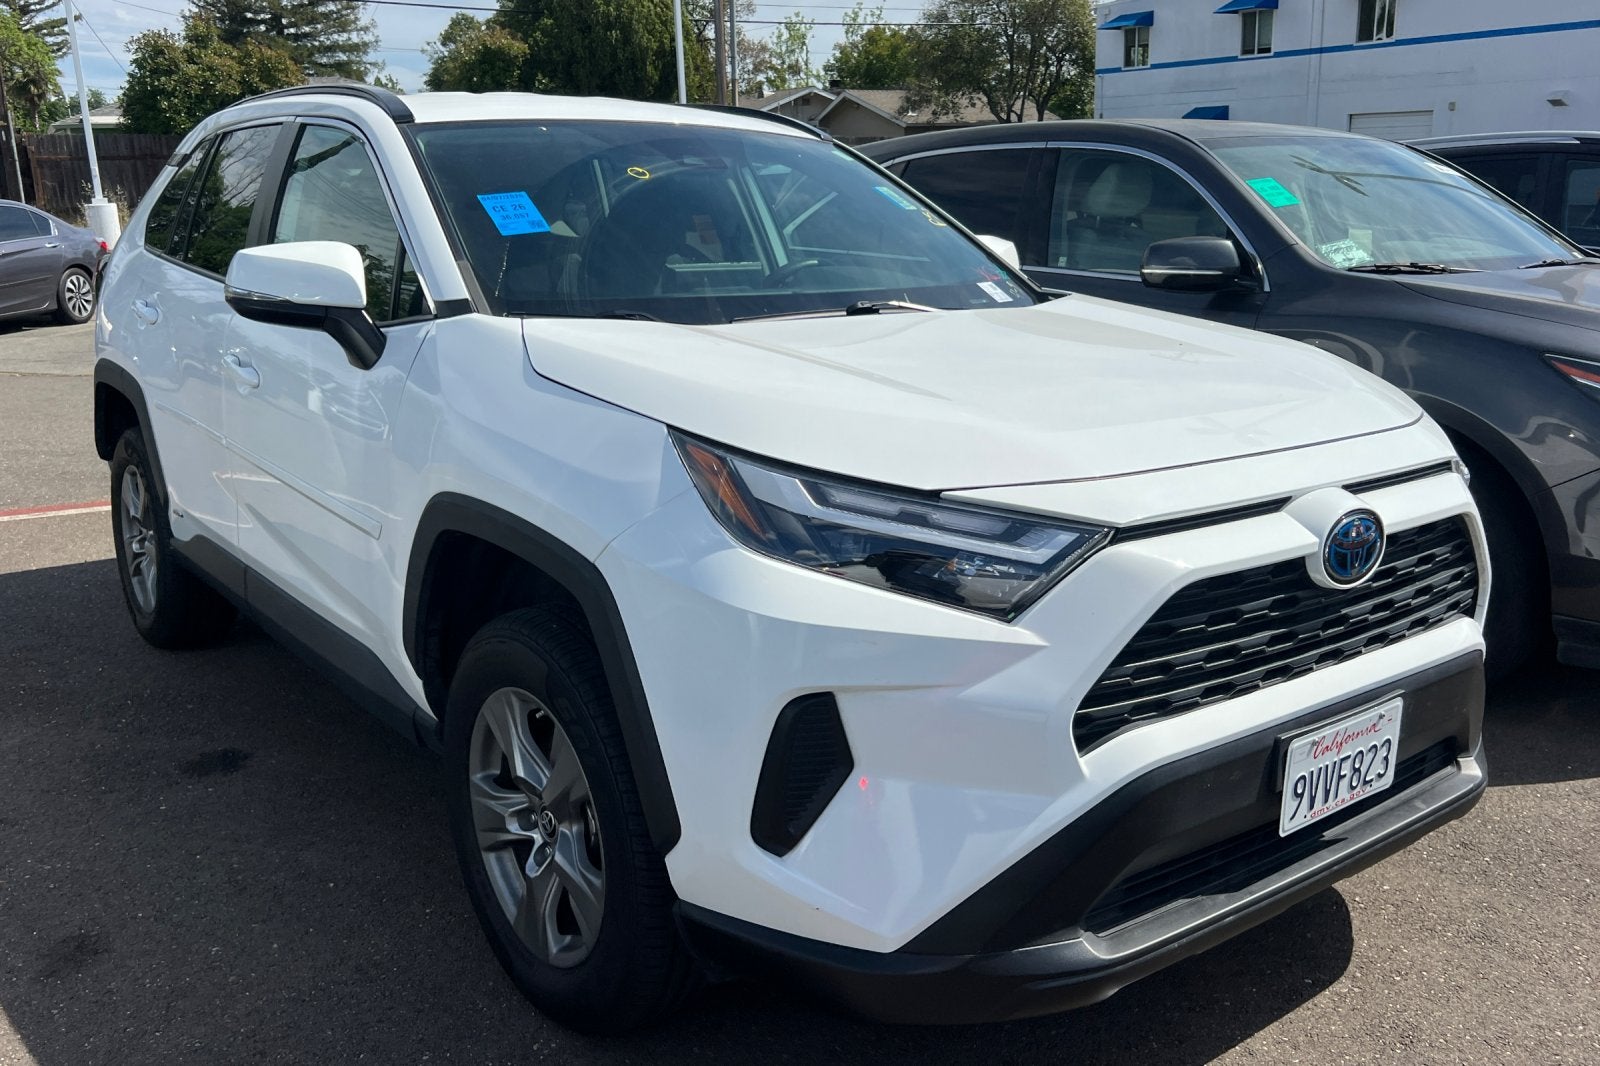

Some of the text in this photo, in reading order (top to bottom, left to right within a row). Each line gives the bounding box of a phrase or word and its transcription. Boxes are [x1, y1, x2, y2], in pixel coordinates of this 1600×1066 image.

[492, 203, 526, 213] CE 26
[1313, 721, 1381, 760] California
[1290, 738, 1392, 821] 9VVF823
[1310, 787, 1367, 819] dmv.ca.gov
